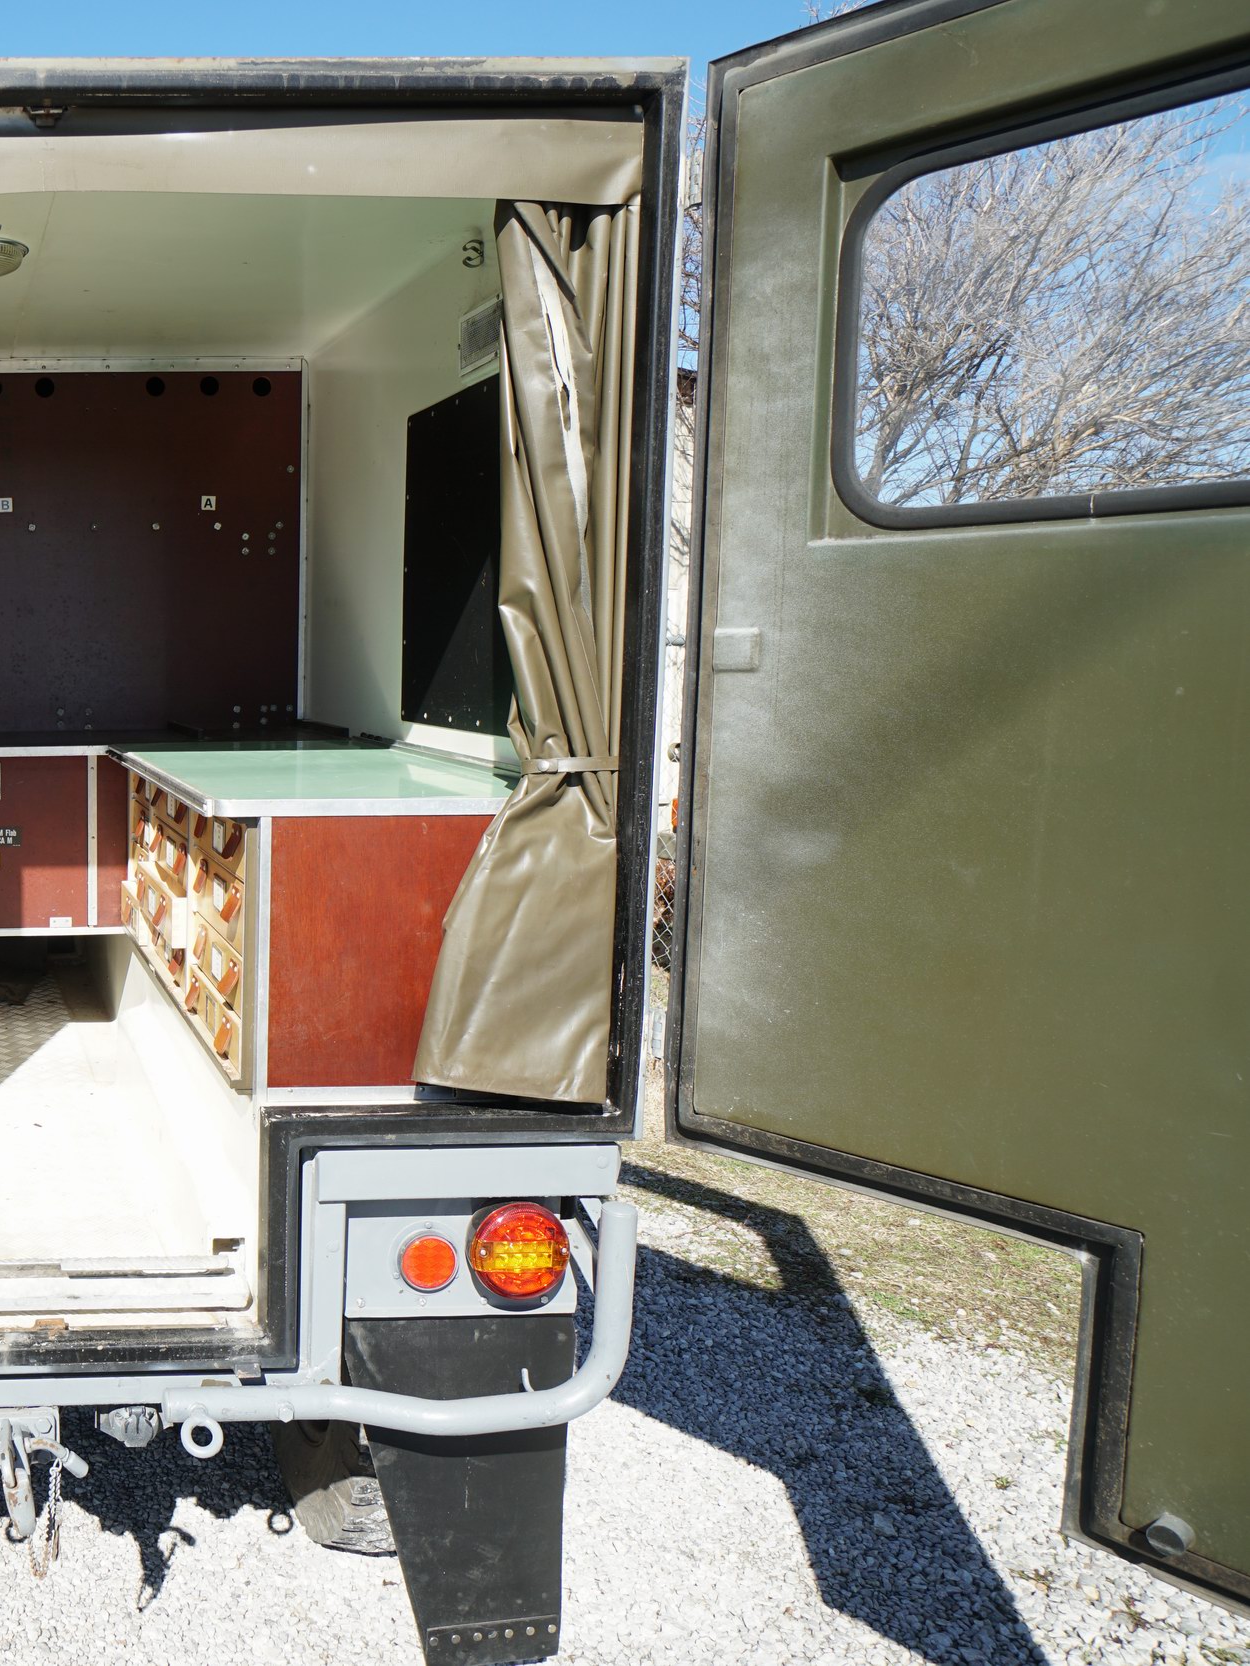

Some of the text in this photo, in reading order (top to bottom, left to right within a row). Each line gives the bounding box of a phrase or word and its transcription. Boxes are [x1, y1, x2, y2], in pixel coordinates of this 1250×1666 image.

[1, 500, 10, 510] B
[204, 498, 213, 508] A
[5, 829, 17, 837] Flab
